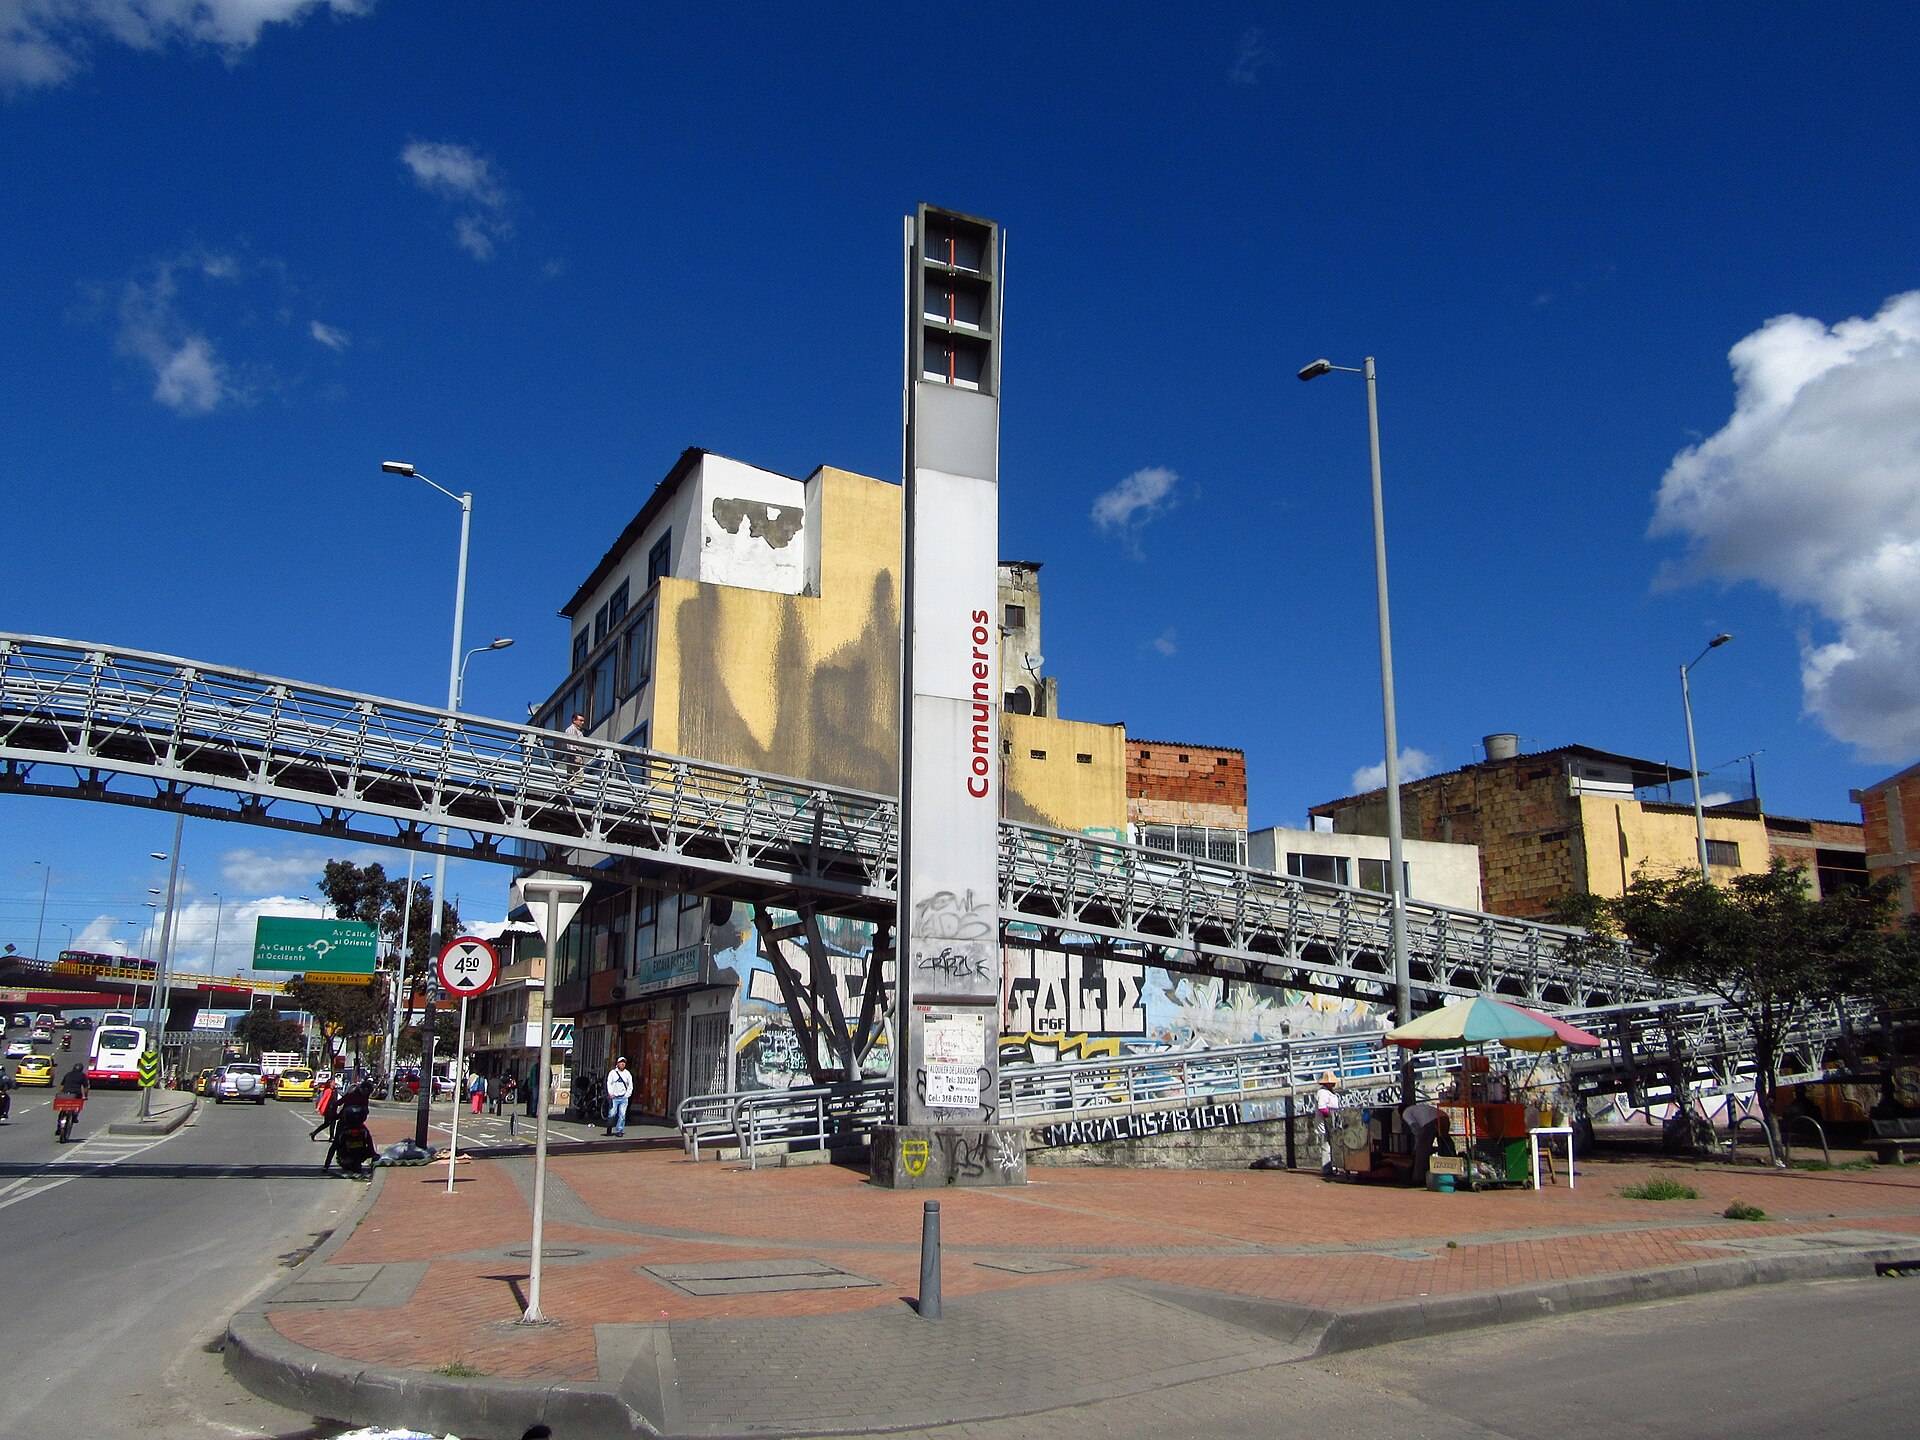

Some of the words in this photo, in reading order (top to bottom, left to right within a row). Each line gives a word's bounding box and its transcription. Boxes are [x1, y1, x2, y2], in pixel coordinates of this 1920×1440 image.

[967, 610, 989, 798] Comuneros
[345, 930, 366, 938] Calle
[343, 938, 373, 947] Oriente
[259, 943, 272, 951] Av
[273, 943, 295, 952] Calle
[256, 952, 265, 960] al
[266, 952, 306, 961] Occidente
[930, 1065, 949, 1075] ALQUILER
[949, 1066, 954, 1075] DE
[942, 1095, 952, 1103] 318
[952, 1095, 963, 1104] 678
[964, 1096, 977, 1104] 7637
